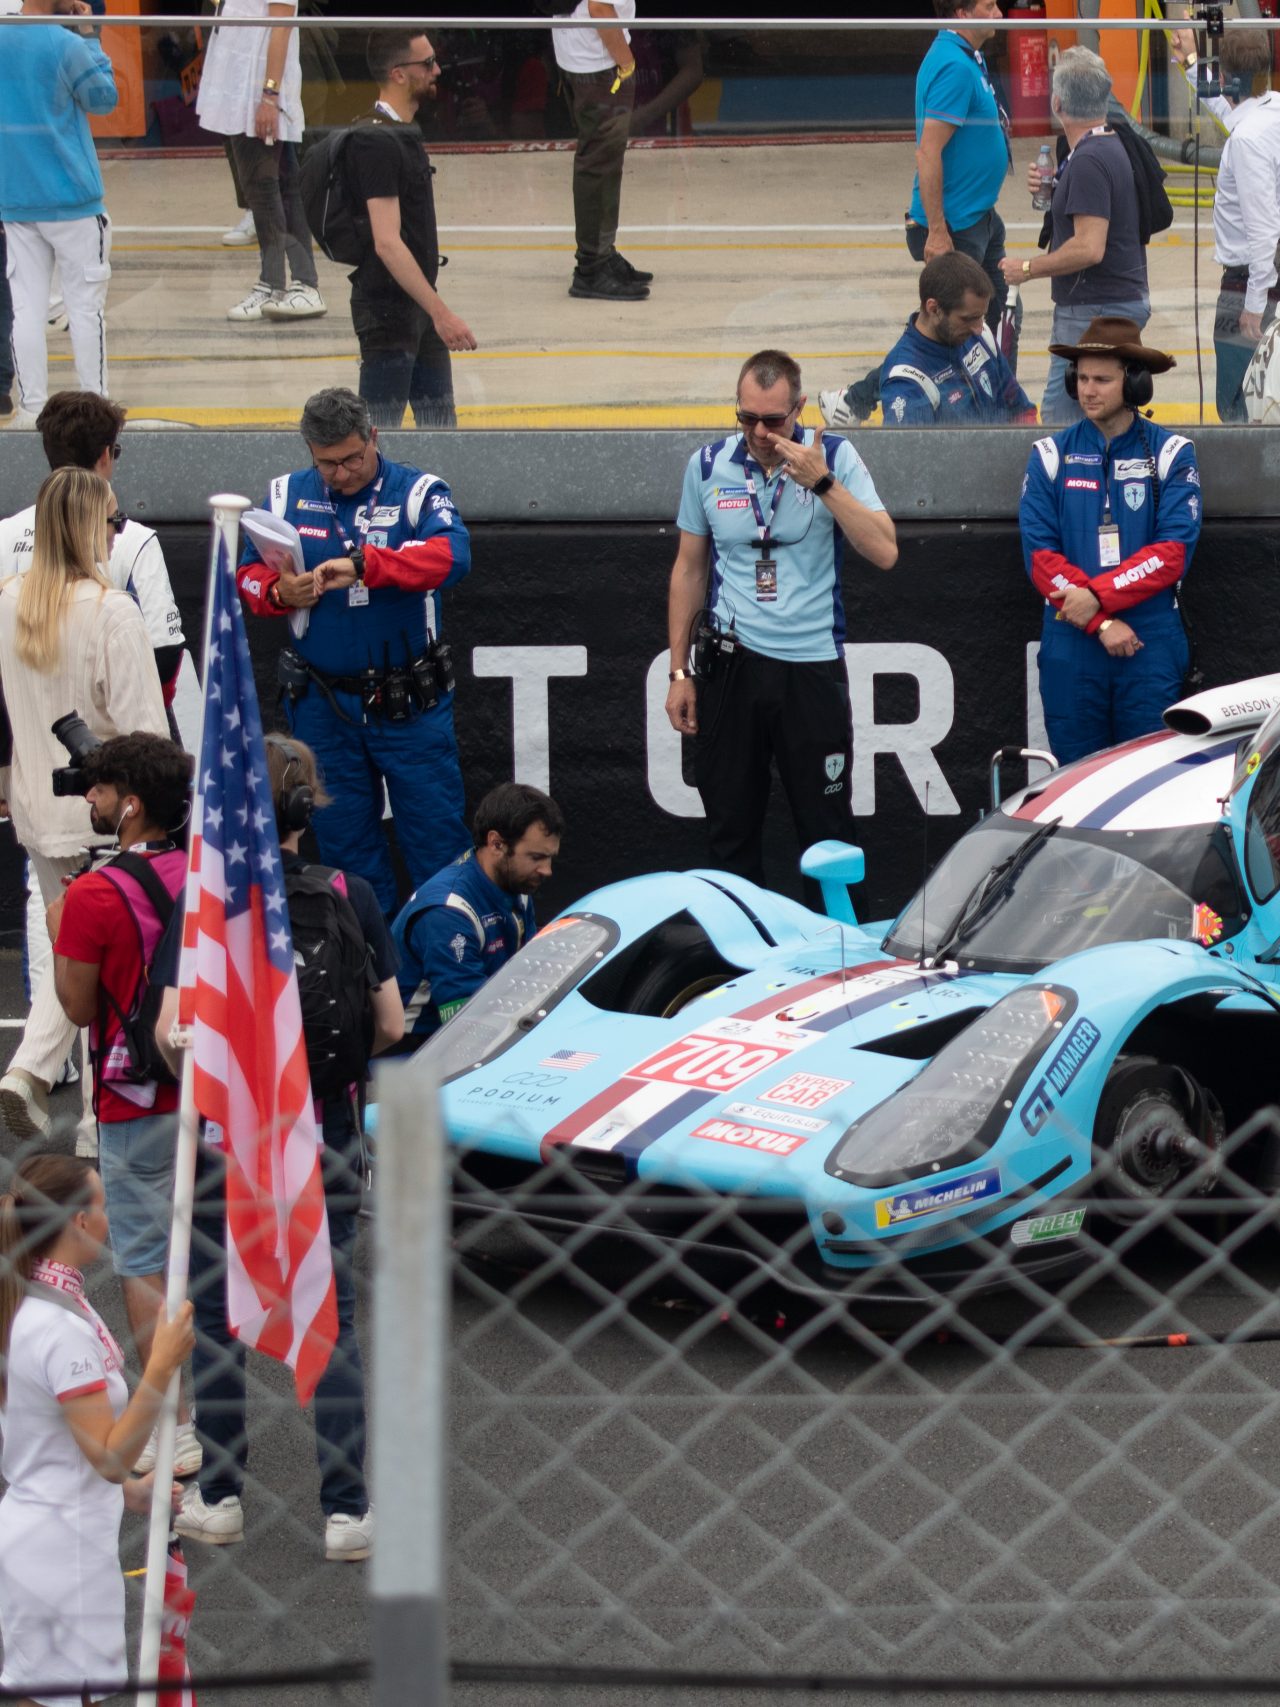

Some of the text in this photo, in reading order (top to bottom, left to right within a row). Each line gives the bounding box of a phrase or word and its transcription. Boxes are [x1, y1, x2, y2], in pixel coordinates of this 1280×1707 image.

[1066, 479, 1098, 489] MOTUL
[718, 499, 749, 509] MOTUL
[299, 526, 327, 538] MOTUL
[1113, 555, 1164, 590] MOTUL
[1221, 698, 1271, 718] BENSON
[641, 1035, 779, 1087] 709
[787, 1074, 845, 1093] HYPER
[1020, 1020, 1099, 1137] GT MANAGER
[467, 1086, 561, 1106] PODIUM
[767, 1084, 829, 1107] CAR
[697, 1121, 799, 1153] MOTUL
[914, 1180, 987, 1211] MICHELIN
[1027, 1209, 1086, 1234] GREEN
